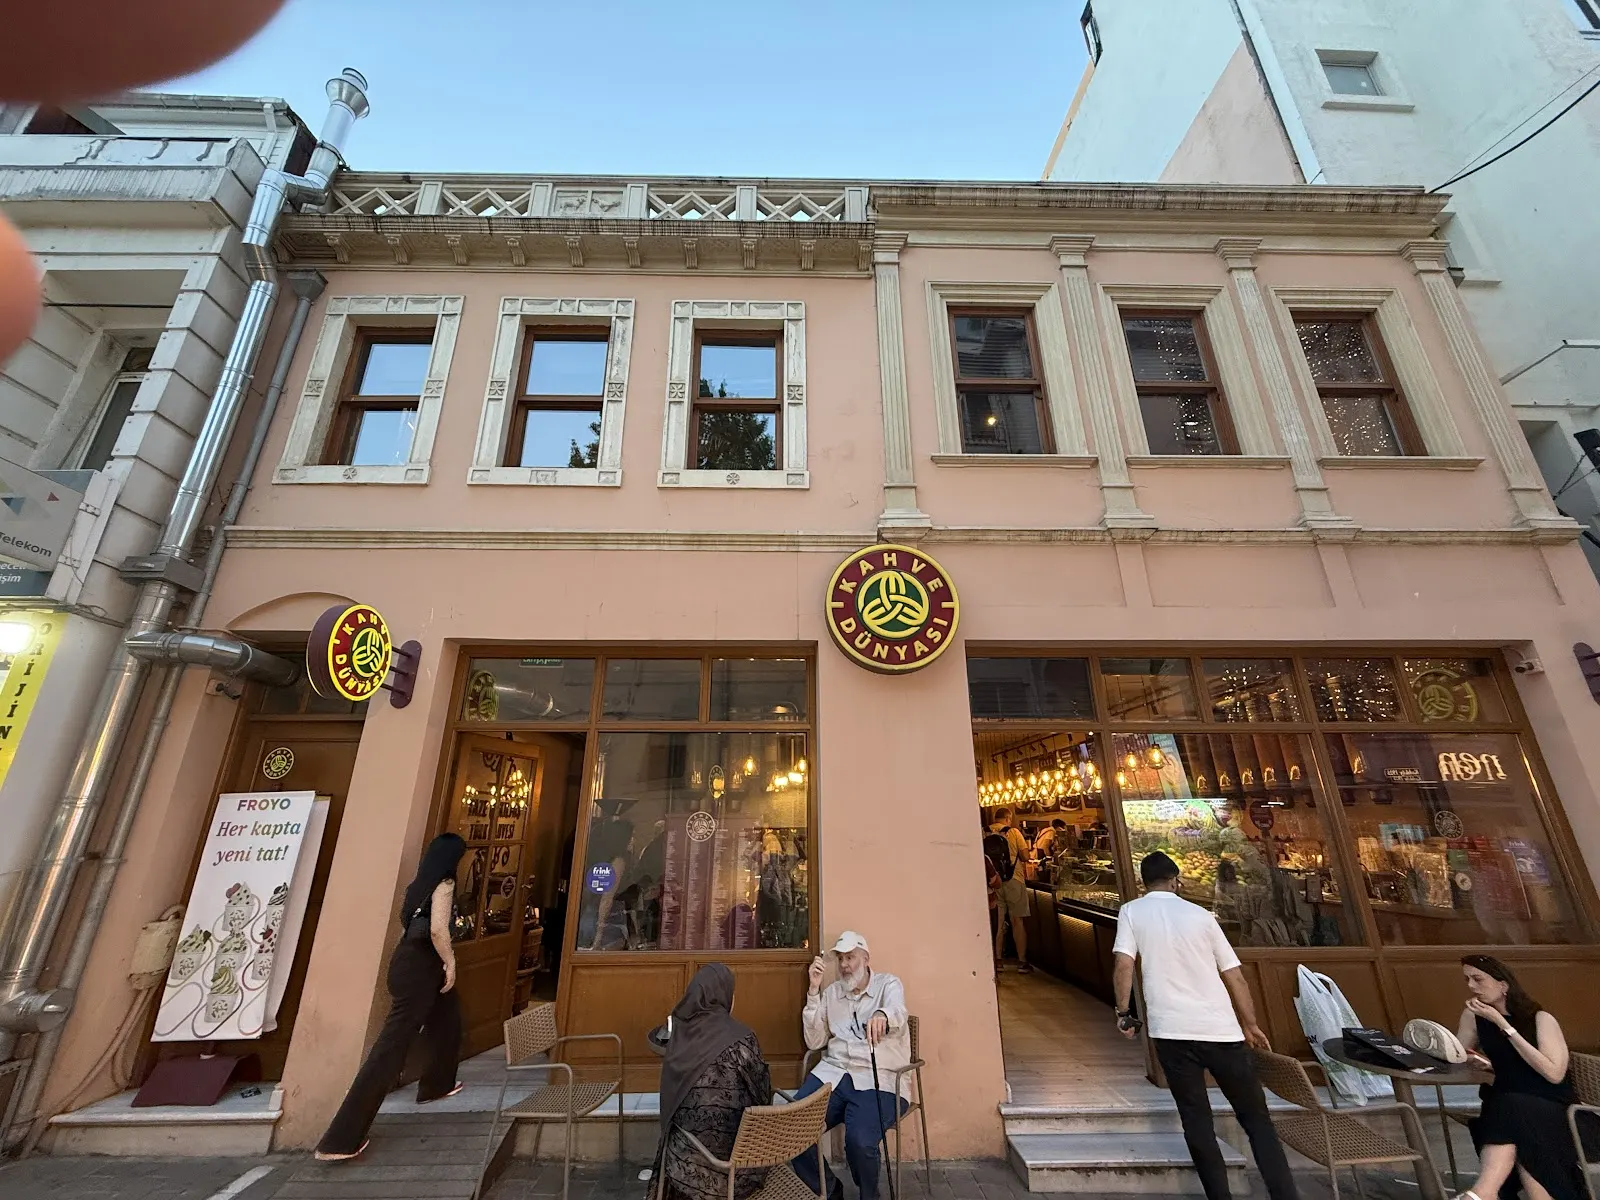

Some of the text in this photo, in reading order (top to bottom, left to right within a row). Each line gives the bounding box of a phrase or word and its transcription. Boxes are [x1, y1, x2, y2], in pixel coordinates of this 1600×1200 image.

[0, 532, 52, 557] Telekom
[839, 552, 944, 594] KAHVE
[342, 612, 391, 652] KAHVE
[839, 617, 949, 660] DÜNYASI
[335, 654, 386, 694] DÜNYASI
[237, 798, 291, 811] FROYO
[216, 821, 301, 840] Her kapta
[213, 845, 289, 866] yeni tat!
[593, 866, 611, 875] frink
